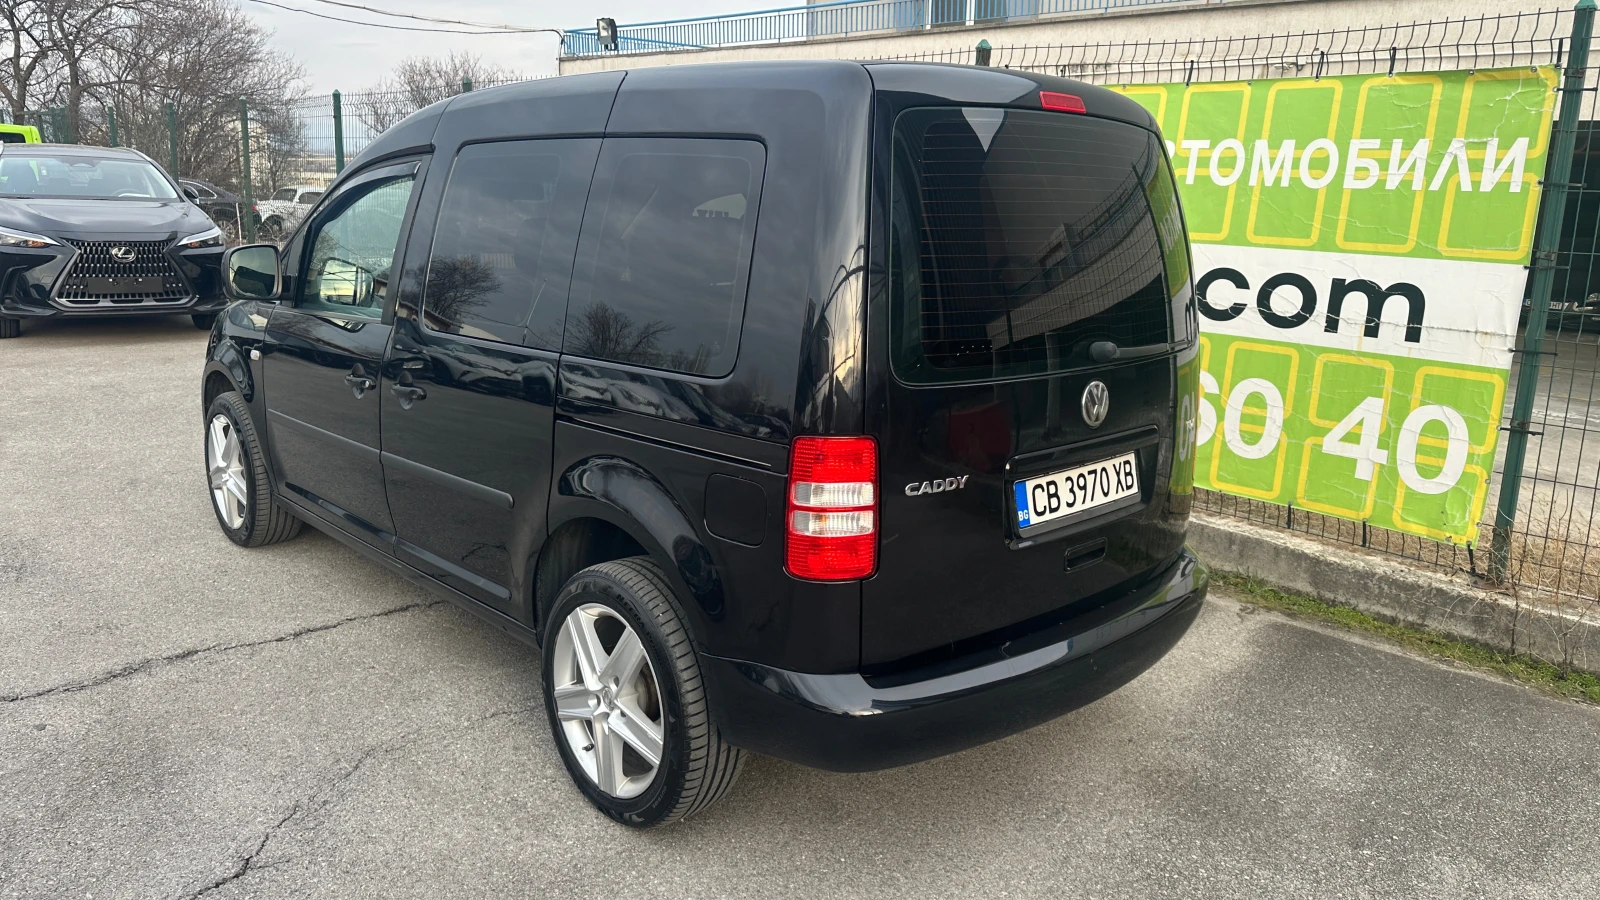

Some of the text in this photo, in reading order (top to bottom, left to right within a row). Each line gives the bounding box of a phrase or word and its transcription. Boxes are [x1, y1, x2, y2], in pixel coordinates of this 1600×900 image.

[1165, 137, 1530, 193] ТОМОБИЛИ
[1196, 266, 1426, 343] com
[1322, 396, 1470, 495] 40
[904, 475, 969, 497] CADDY
[1031, 459, 1135, 517] CB 3970 XB
[1017, 509, 1029, 521] BG
